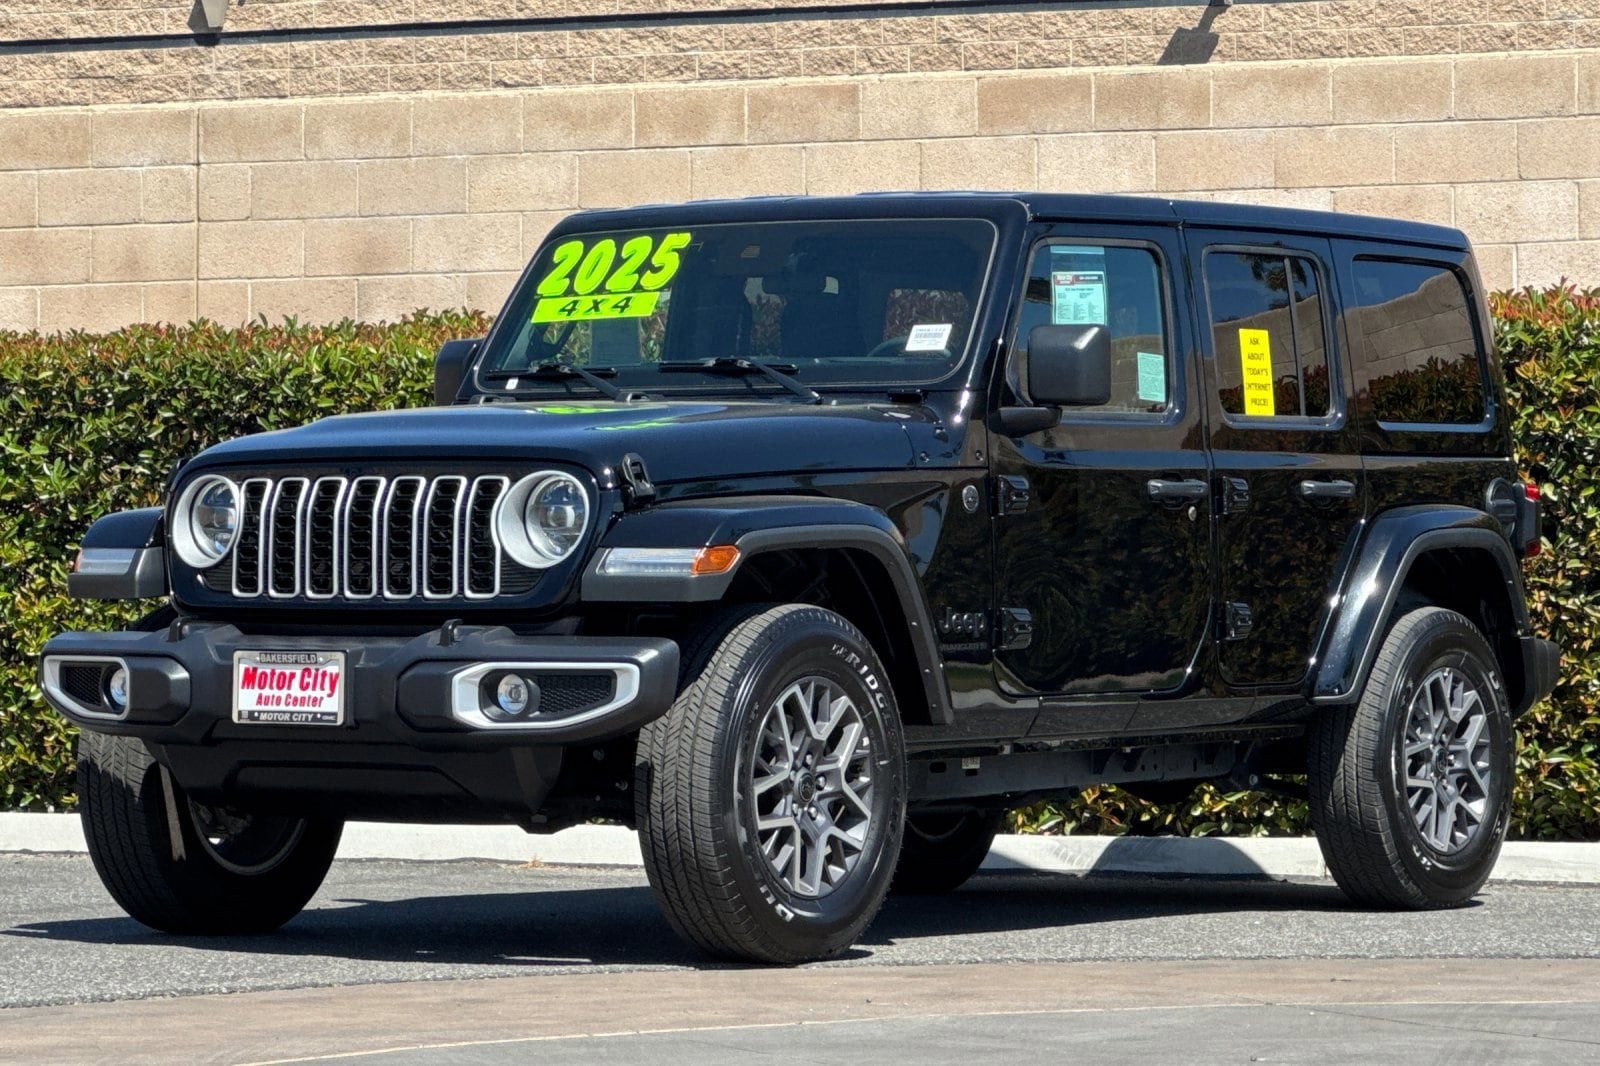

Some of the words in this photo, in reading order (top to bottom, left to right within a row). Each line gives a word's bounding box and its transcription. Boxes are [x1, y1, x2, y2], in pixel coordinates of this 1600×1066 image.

[537, 232, 691, 296] 2025
[1247, 353, 1265, 361] ABOUT
[1246, 382, 1271, 391] INTERNET
[939, 606, 986, 638] Jeep
[260, 652, 317, 663] BAKERSFIELD
[241, 666, 296, 690] Motor
[299, 667, 339, 697] City
[256, 693, 281, 706] Auto
[284, 694, 324, 707] Center
[259, 711, 290, 721] MOTOR
[292, 712, 315, 722] CITY
